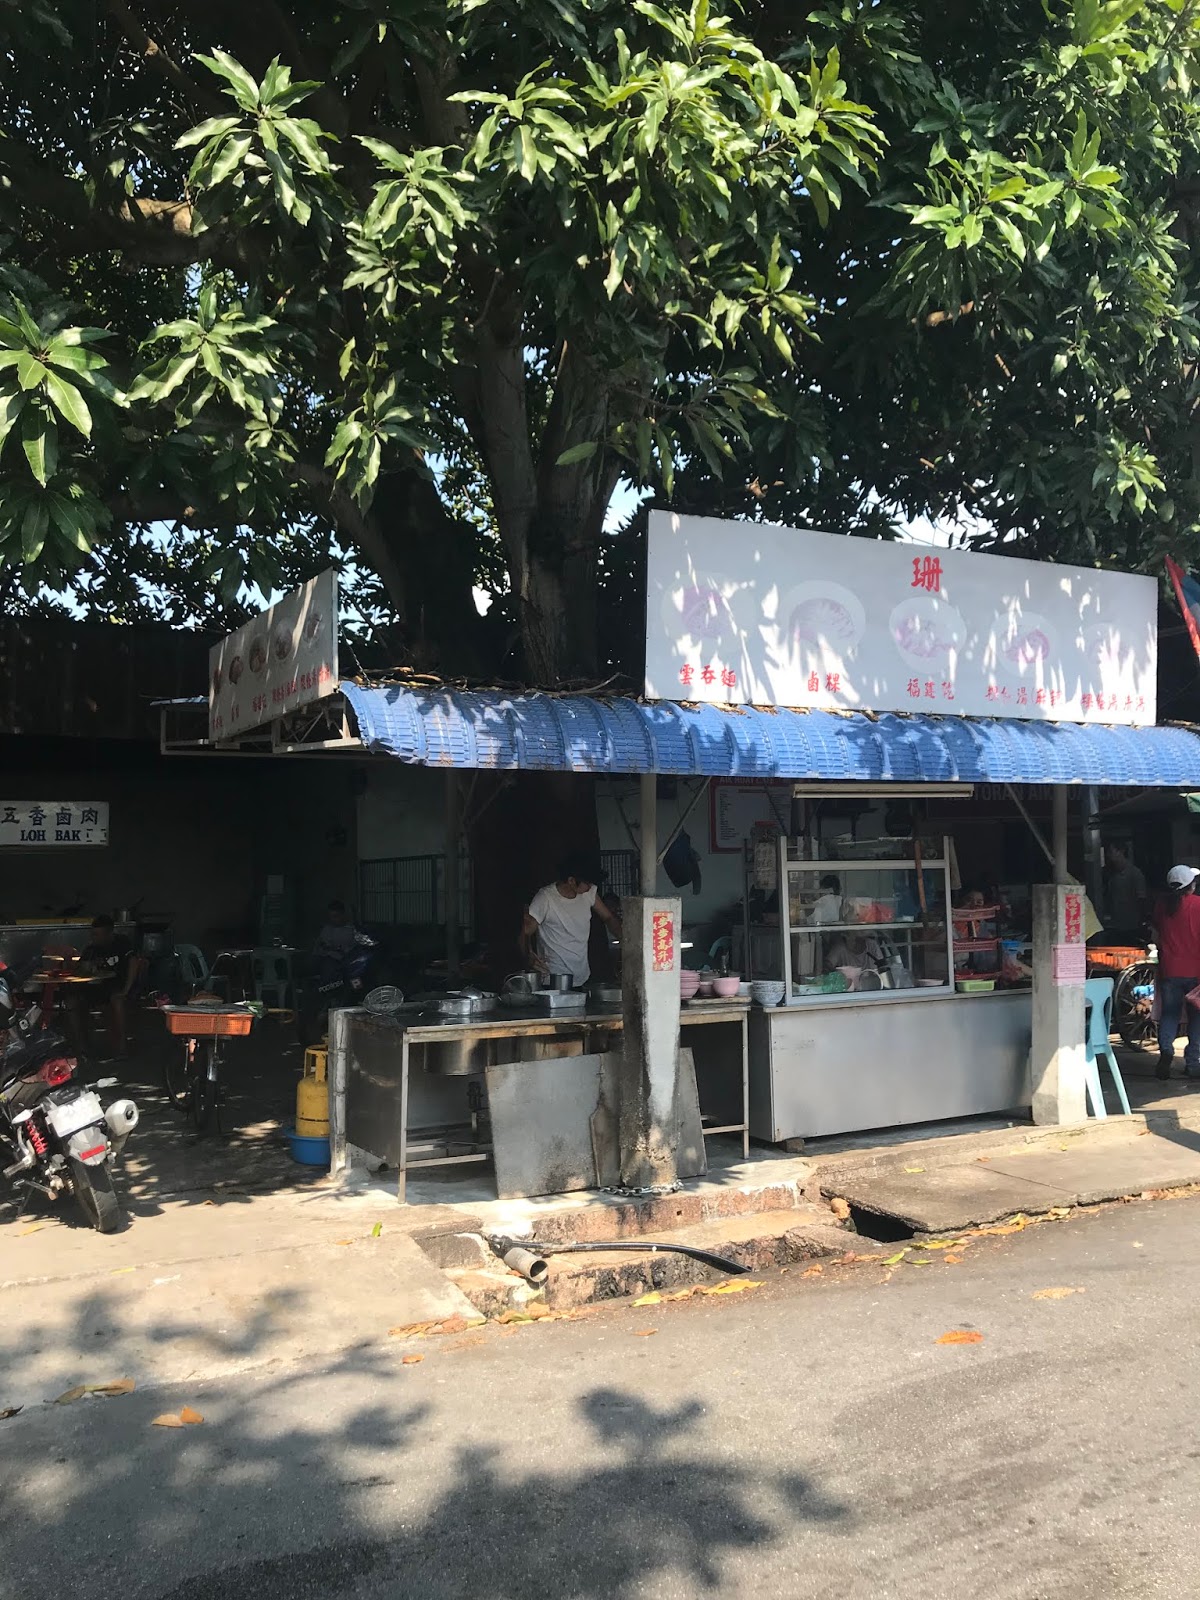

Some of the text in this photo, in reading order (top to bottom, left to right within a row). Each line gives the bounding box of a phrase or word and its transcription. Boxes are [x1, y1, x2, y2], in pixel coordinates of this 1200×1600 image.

[911, 556, 943, 592] 珊
[679, 664, 737, 687] 雲吞麵
[20, 830, 81, 841] LOH BAK
